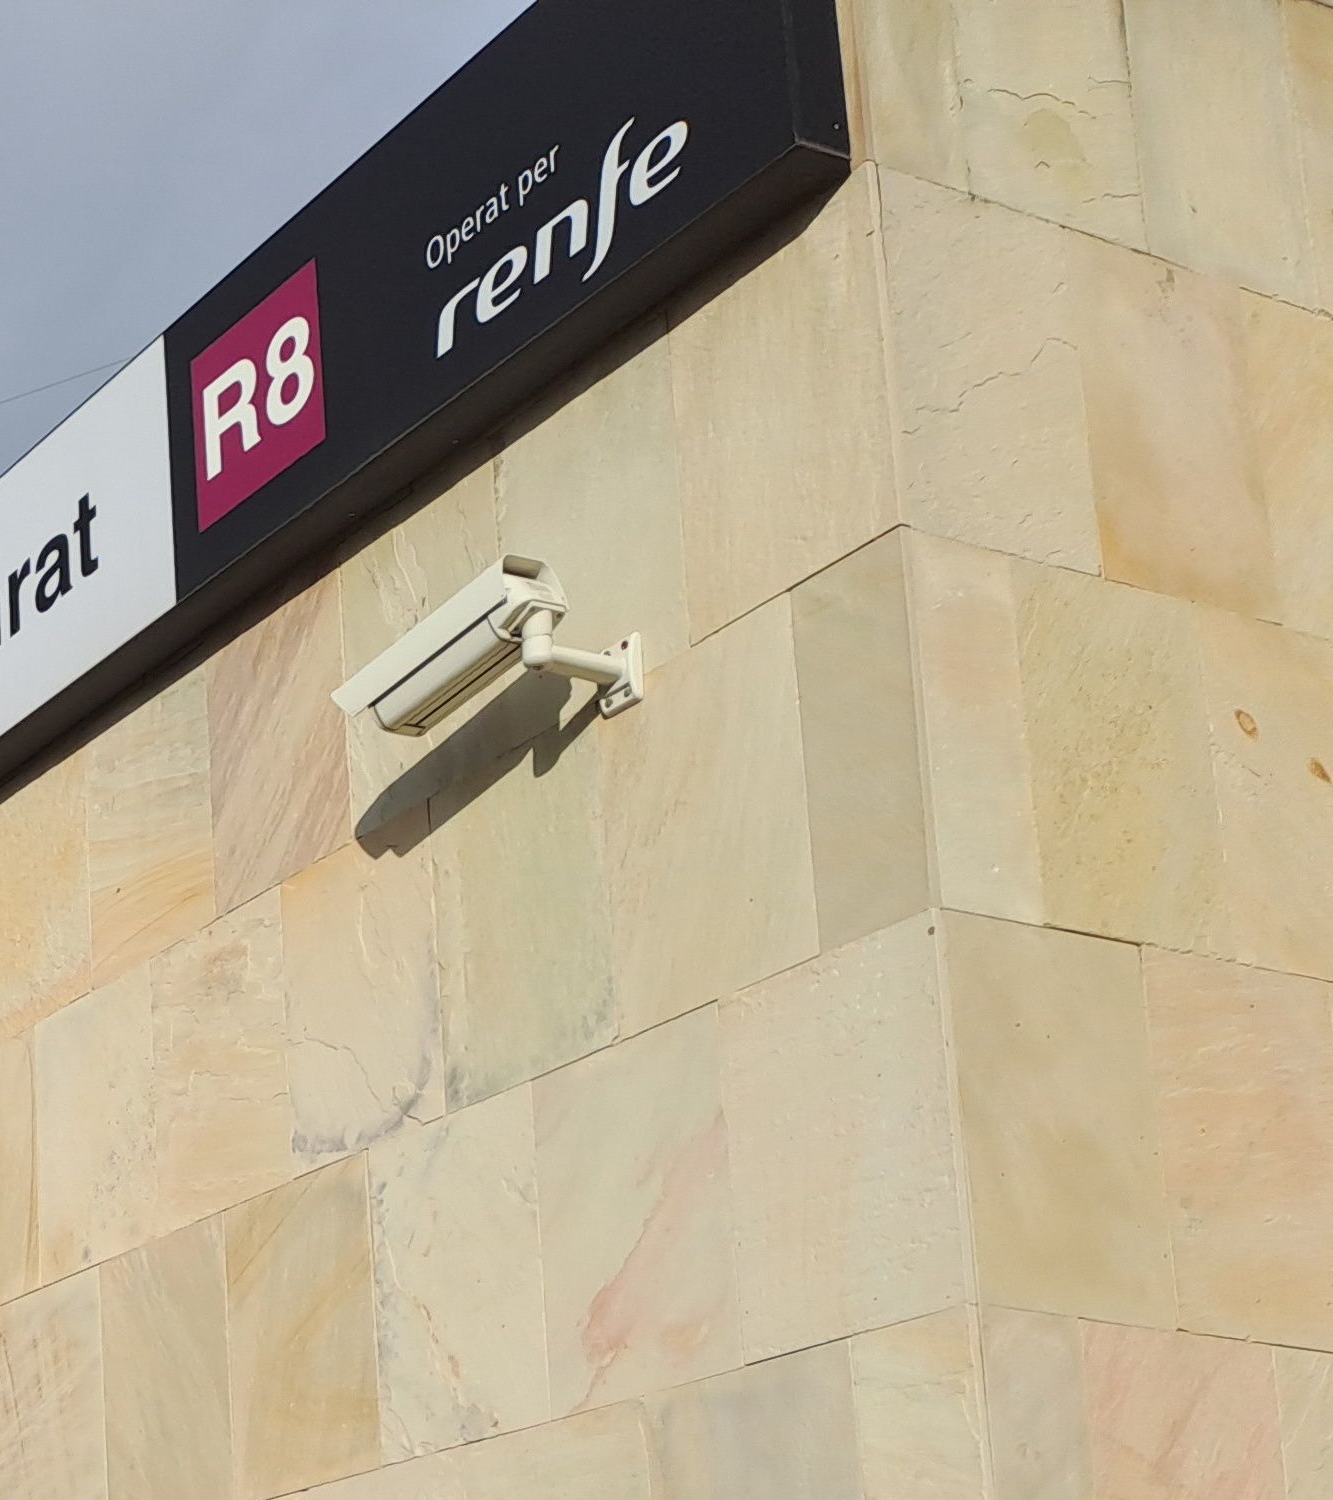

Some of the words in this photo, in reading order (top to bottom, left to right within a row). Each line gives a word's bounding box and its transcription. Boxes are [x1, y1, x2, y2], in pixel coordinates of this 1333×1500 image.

[423, 191, 511, 270] Operat
[517, 143, 561, 202] per
[434, 116, 690, 360] renfe
[203, 315, 316, 483] R8
